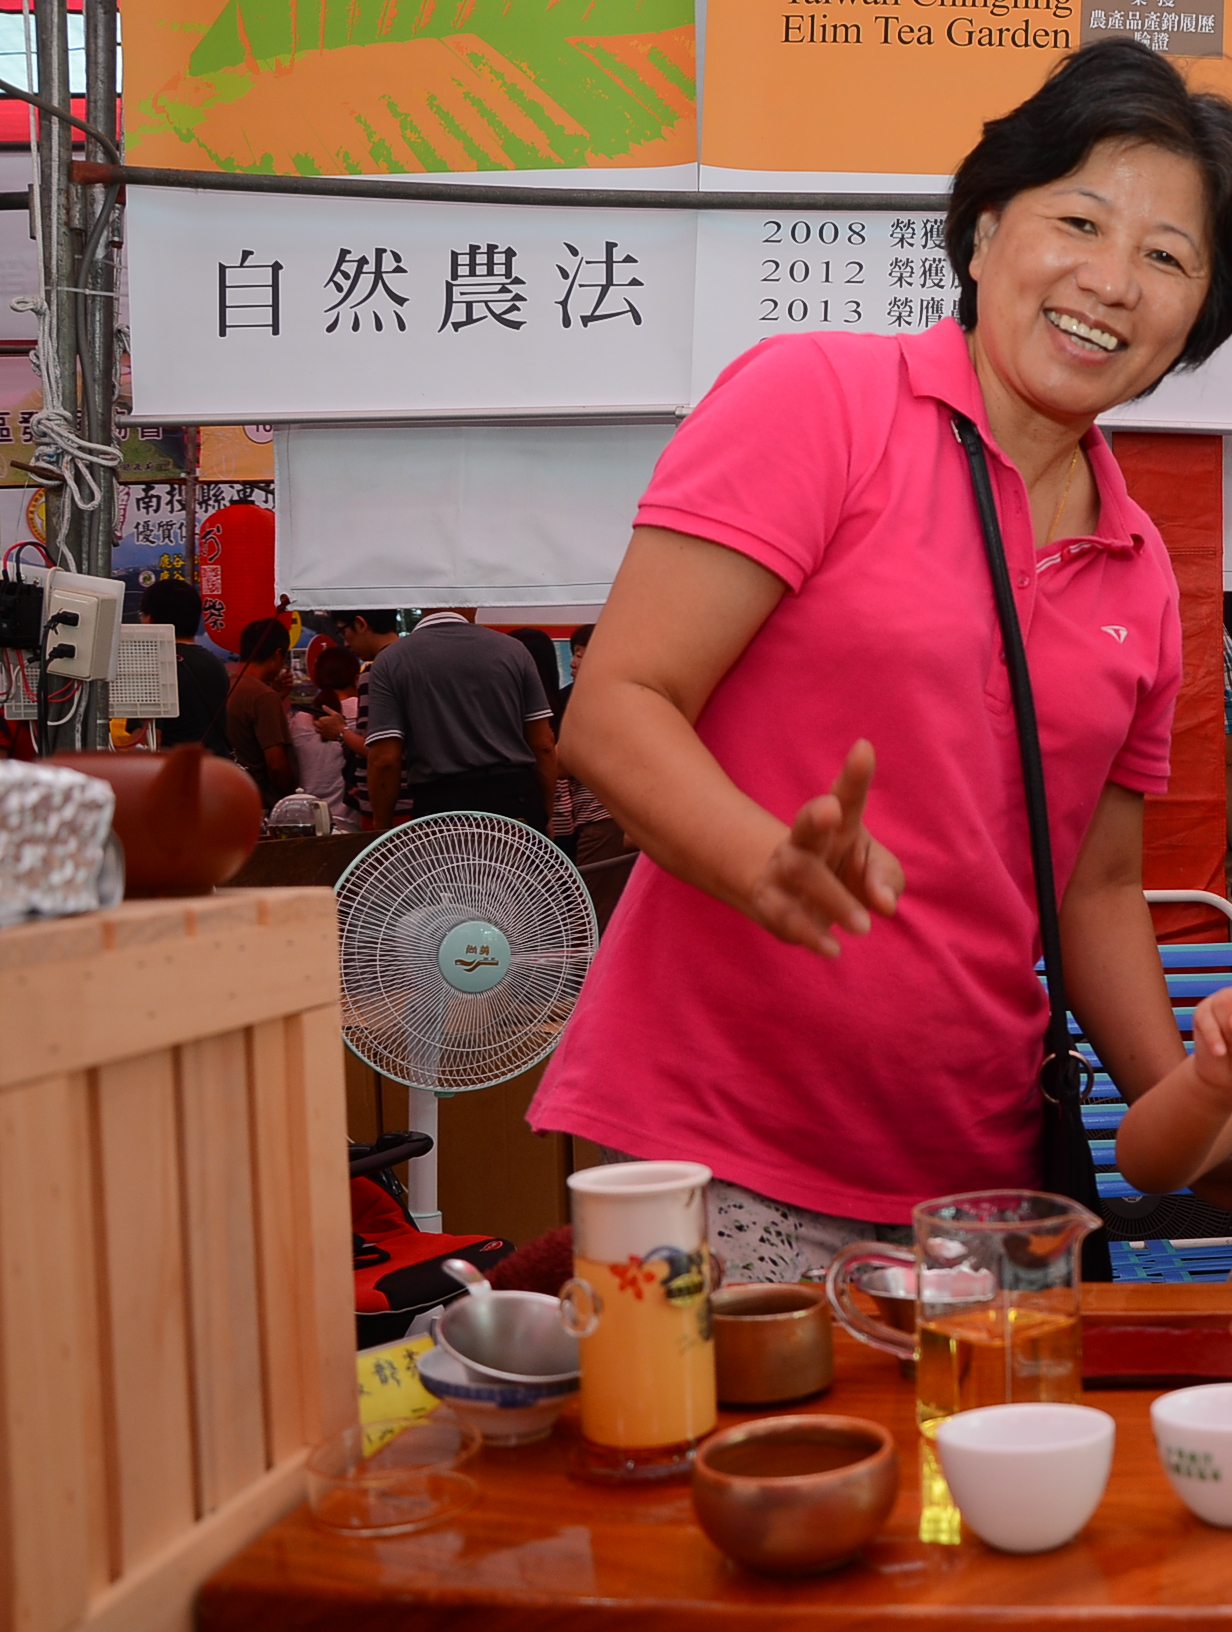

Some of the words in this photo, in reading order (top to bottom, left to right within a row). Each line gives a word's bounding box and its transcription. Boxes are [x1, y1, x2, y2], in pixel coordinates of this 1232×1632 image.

[781, 14, 863, 44] Elim
[874, 15, 935, 46] Tea
[946, 17, 1072, 49] Garden
[1089, 9, 1215, 34] 農產品產銷履歷
[762, 220, 867, 245] 2008
[760, 259, 865, 284] 2012
[888, 257, 962, 290] 榮獲
[217, 240, 645, 338] 自然農法
[758, 298, 863, 324] 2013
